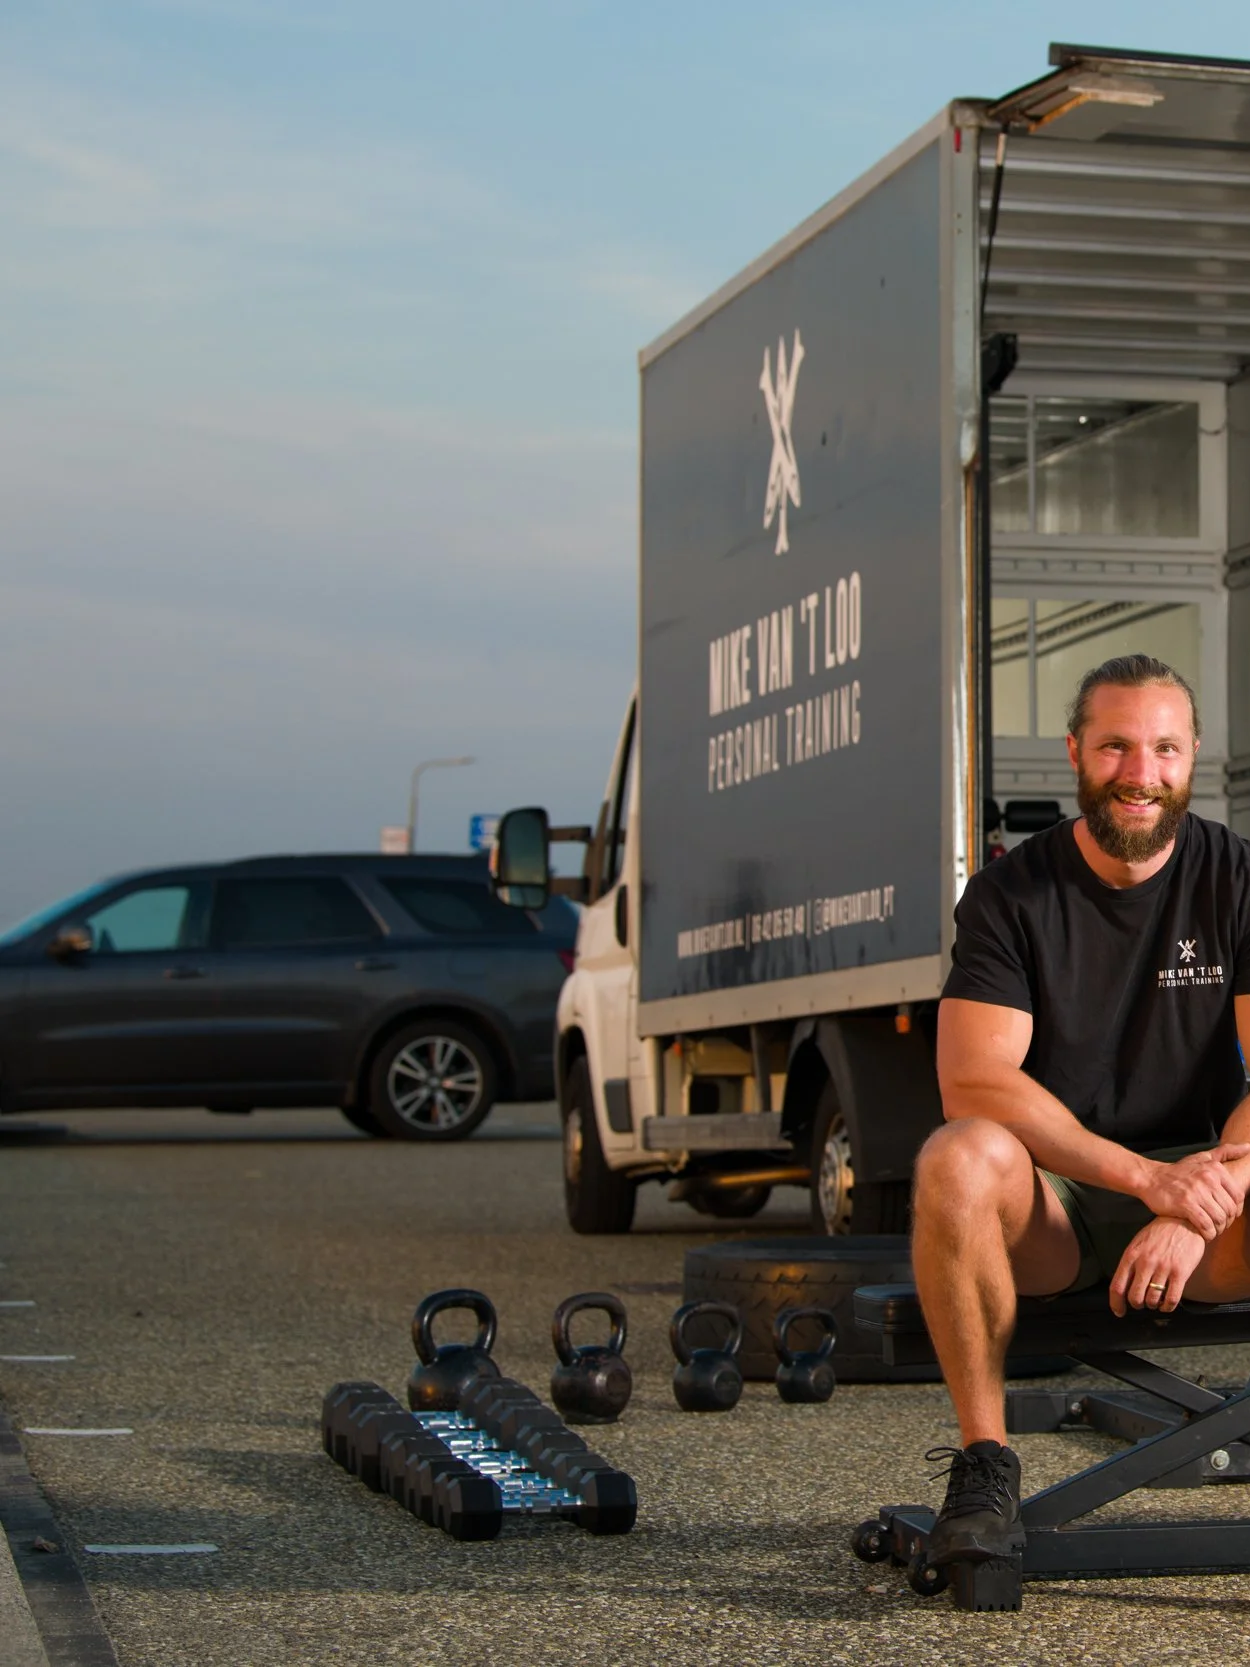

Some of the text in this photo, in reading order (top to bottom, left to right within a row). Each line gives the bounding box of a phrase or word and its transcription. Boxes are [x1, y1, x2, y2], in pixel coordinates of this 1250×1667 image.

[709, 571, 860, 717] MIKE VAN 'T LOO
[708, 680, 860, 793] PERSONAL TRAINING
[1158, 970, 1176, 979] MIKE
[1177, 968, 1194, 978] VAN
[1208, 965, 1223, 976] LOO
[1158, 976, 1224, 988] PERSONAL TRAINING
